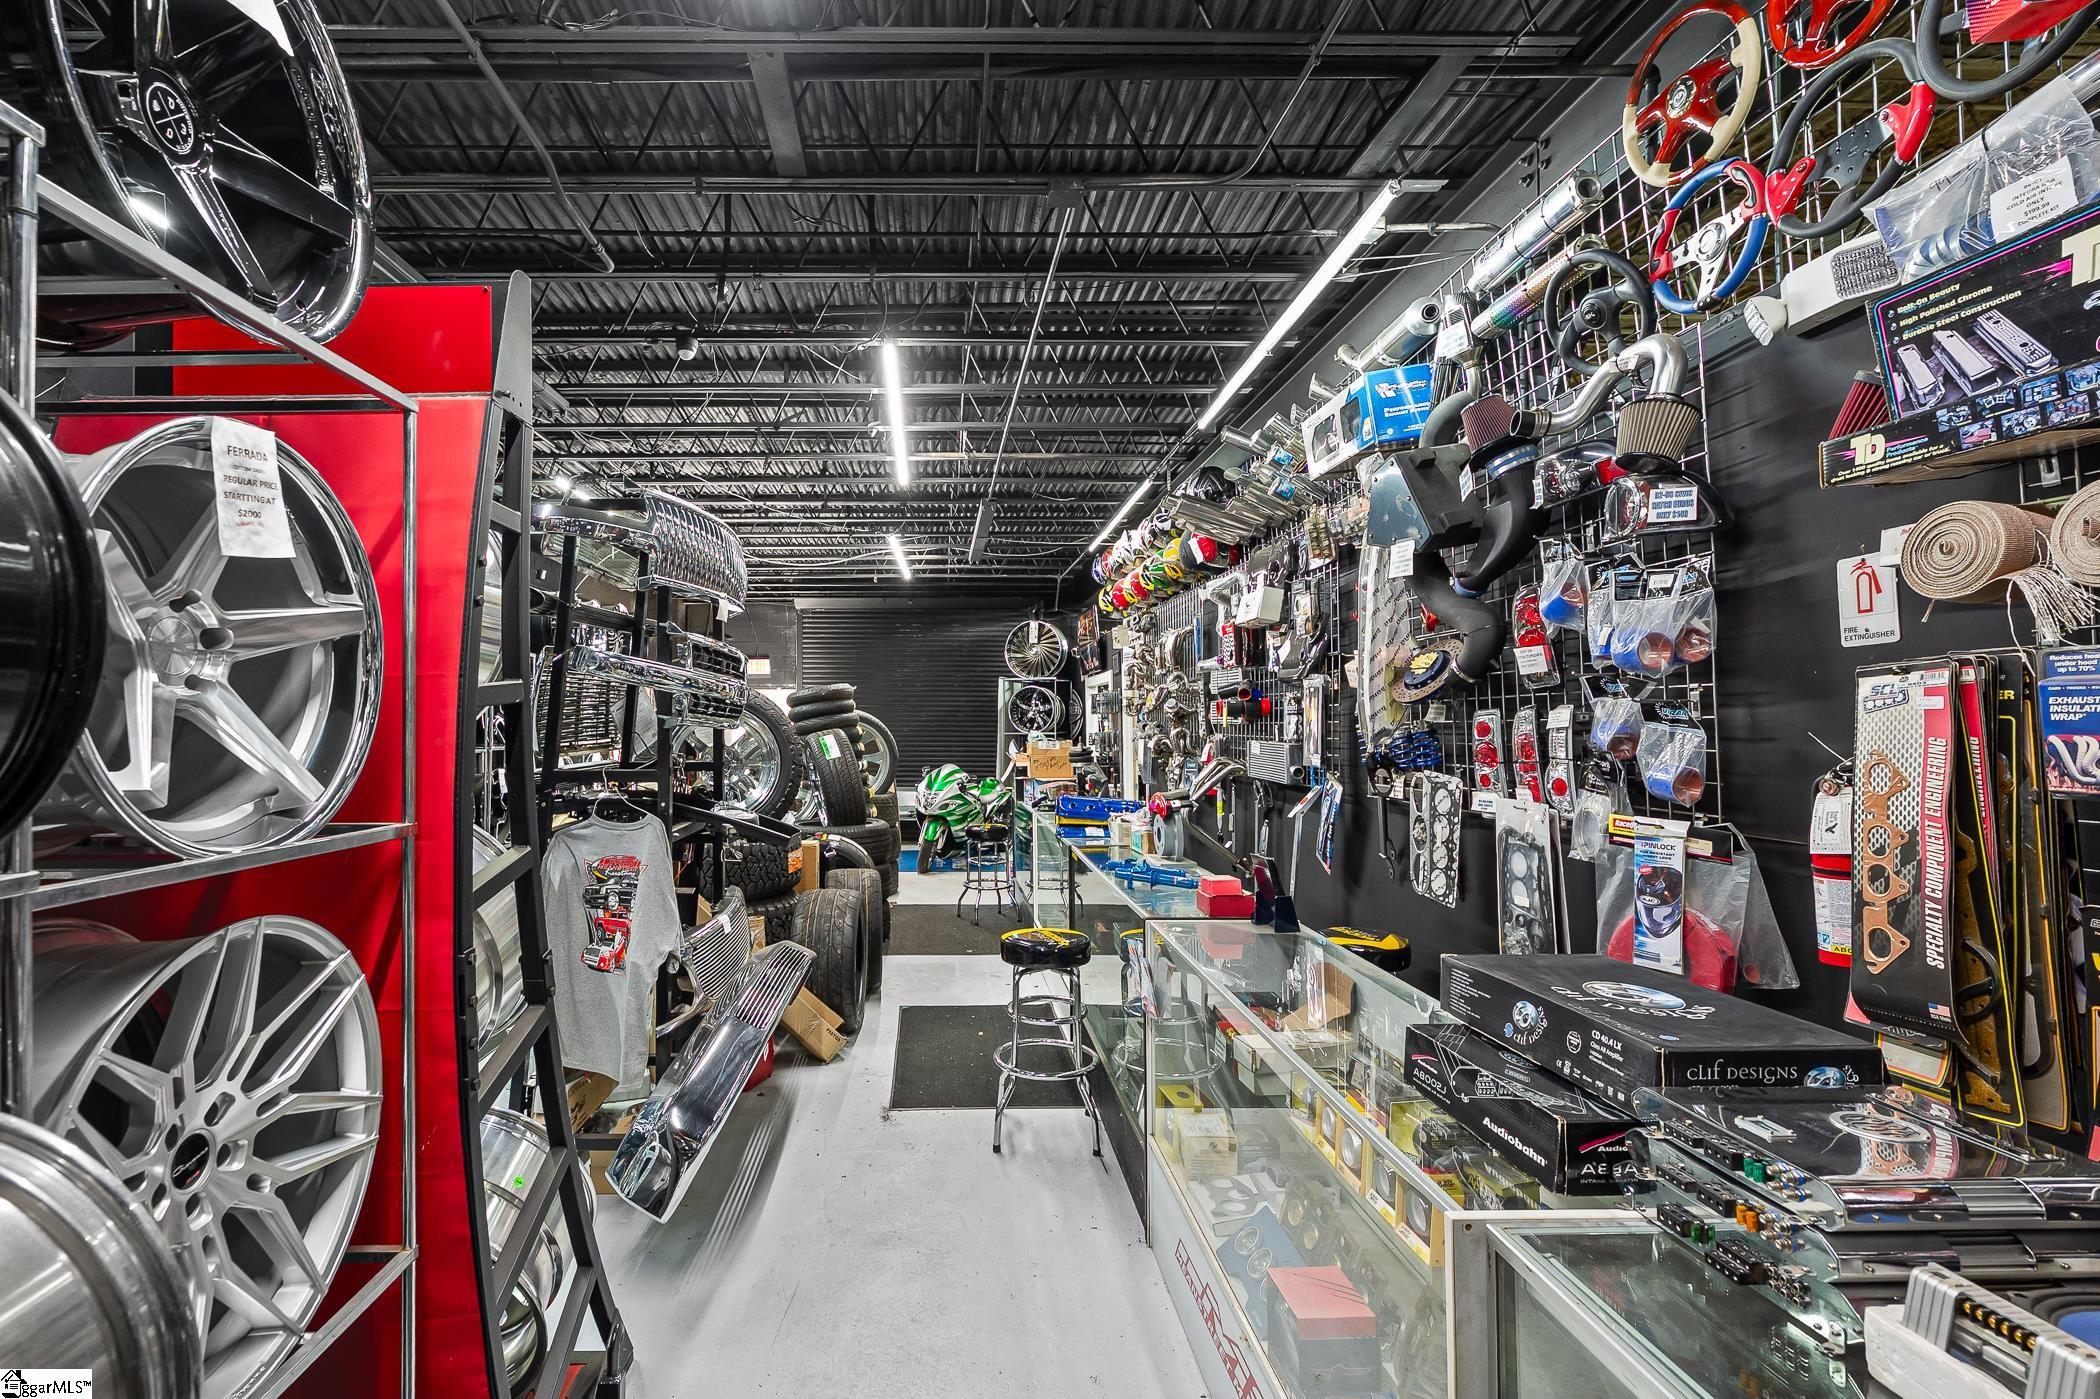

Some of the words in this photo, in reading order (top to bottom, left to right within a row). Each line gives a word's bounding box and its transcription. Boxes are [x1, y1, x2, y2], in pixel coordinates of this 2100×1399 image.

[2006, 199, 2025, 211] COLD
[2023, 201, 2050, 217] $199.99
[2026, 196, 2045, 208] ONLY
[2062, 224, 2100, 287] T
[1896, 296, 1928, 314] Bolt-On
[1929, 282, 1961, 300] Beauty
[1899, 315, 1919, 327] High
[1919, 299, 1956, 320] Polished
[1957, 285, 1993, 304] Chrome
[1902, 324, 1935, 341] Durable
[1935, 313, 1960, 328] Steel
[1960, 289, 2022, 318] Construction
[227, 445, 268, 462] FERRADA
[1850, 433, 1886, 465] TD
[1886, 437, 1929, 453] Performance
[1838, 468, 1852, 477] Over
[1866, 460, 1886, 470] quality
[1902, 448, 1928, 459] available
[1845, 470, 1865, 481] looking
[1871, 463, 1890, 474] strong
[1913, 454, 1924, 462] car
[223, 474, 258, 488] REGULAR
[259, 480, 279, 491] PRICE
[223, 491, 265, 504] STARTTING
[265, 497, 276, 505] AT
[238, 508, 262, 519] $2000
[1843, 626, 1859, 634] FIRE
[1844, 630, 1896, 642] EXTINGUISHER
[2048, 696, 2100, 704] EXHAUST
[1925, 736, 1948, 819] ENGINEERING
[1643, 842, 1676, 851] PINLOCK
[1924, 822, 1946, 898] COMPONENT
[1926, 899, 1945, 970] SPECIALTY
[1591, 1030, 1601, 1040] CD
[1600, 1034, 1613, 1047] 40.4
[1613, 1040, 1622, 1051] LX
[1482, 1115, 1548, 1167] Audiobahn
